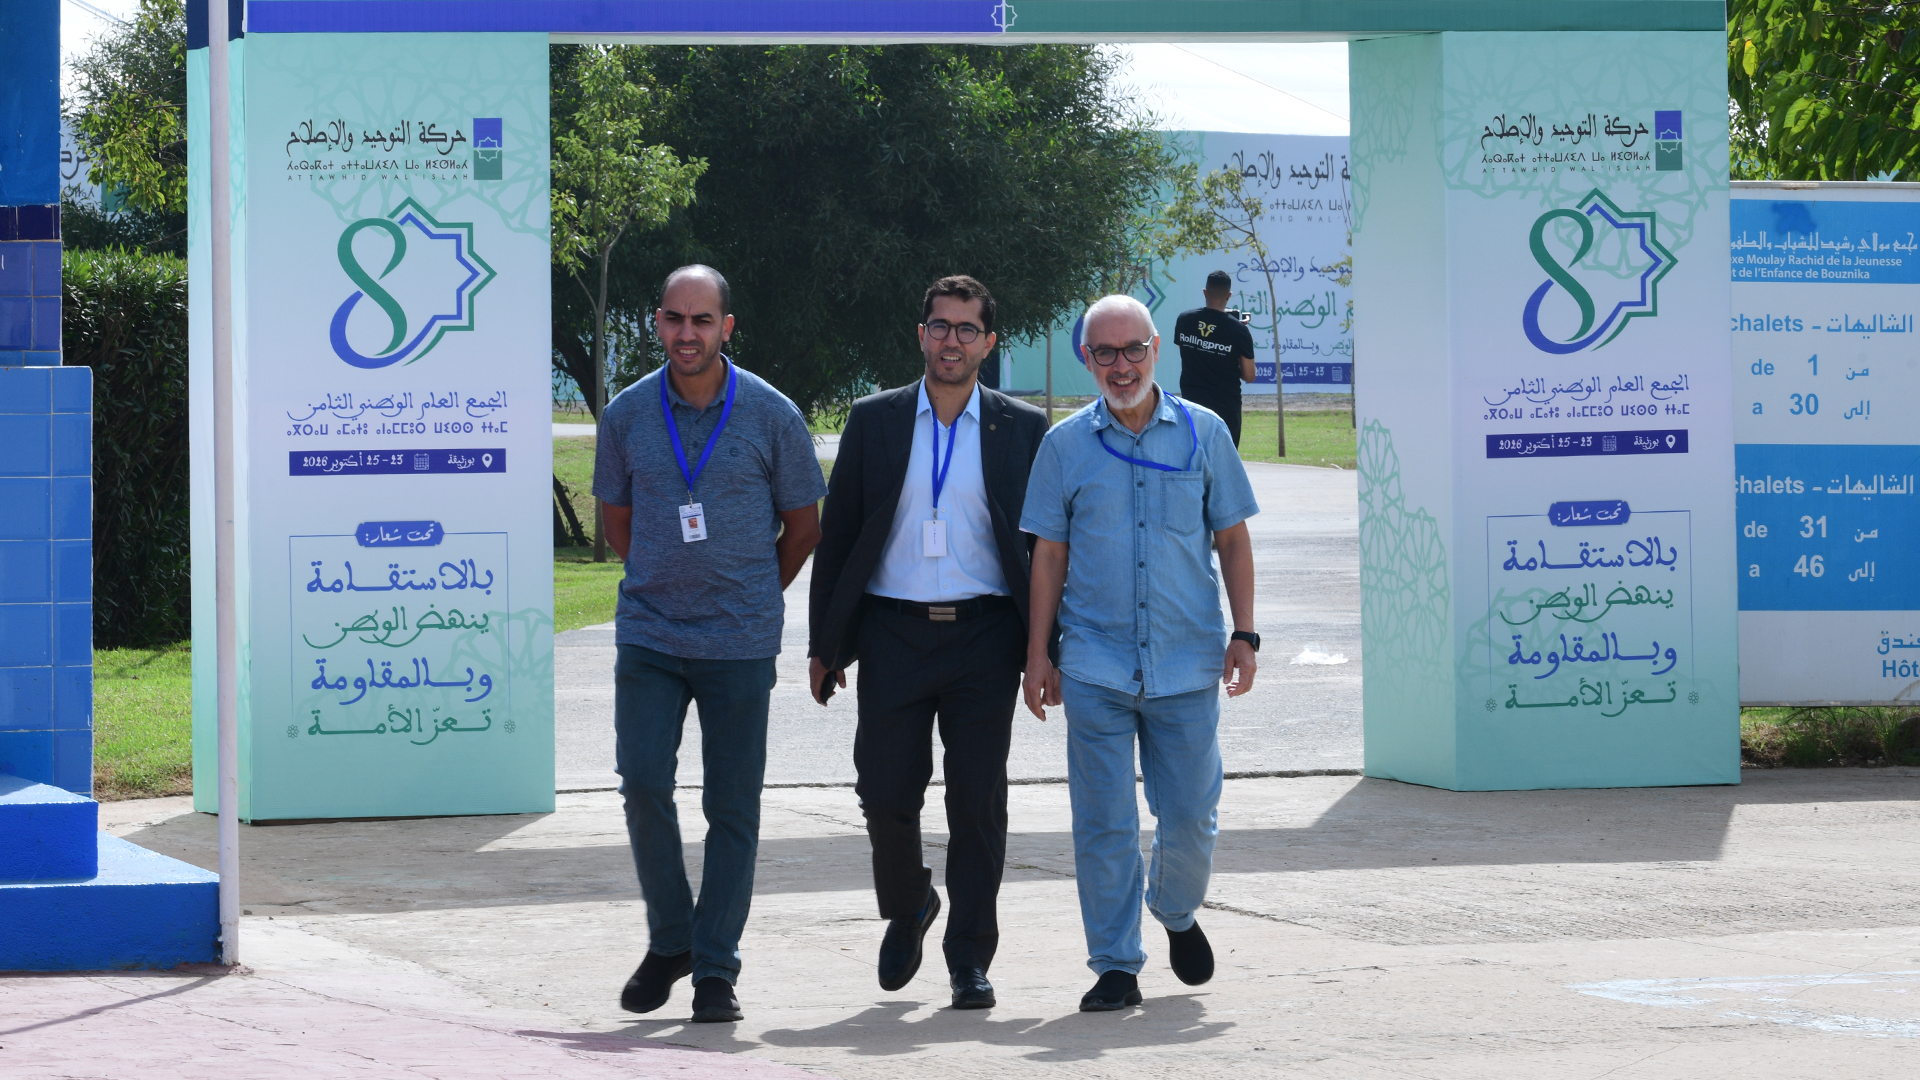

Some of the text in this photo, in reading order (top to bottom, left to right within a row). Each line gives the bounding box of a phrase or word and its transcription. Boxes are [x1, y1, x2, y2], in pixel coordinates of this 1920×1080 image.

[286, 119, 467, 157] حركة التوحيد والإصلاح
[1481, 112, 1649, 150] حركة التوحيد والإصلاح
[1820, 236, 1854, 254] رشيد
[1857, 232, 1890, 252] مولاي
[1892, 232, 1918, 255] مجمع
[1746, 254, 1786, 267] Moulay
[1788, 254, 1824, 266] Rachid
[1826, 255, 1840, 266] de
[1842, 255, 1852, 266] la
[1854, 256, 1902, 266] Jeunesse
[1738, 267, 1752, 278] de
[1805, 268, 1818, 278] de
[1821, 268, 1870, 279] Bouznika
[1826, 313, 1913, 339] الشاليهات
[1180, 332, 1232, 352] Rollingprod
[1750, 354, 1870, 380] de 1 من
[1484, 374, 1690, 406] الجمع العام الوطني الثامن
[286, 391, 508, 421] الجمع العام الوطني الثامن
[1752, 393, 1870, 420] a 30 إلى
[1498, 438, 1522, 450] 2026
[1518, 434, 1555, 454] أكتوبر
[1558, 436, 1570, 448] 25
[1580, 436, 1592, 446] 23
[1634, 436, 1660, 450] بوزنيقة
[302, 456, 328, 467] 2026
[323, 452, 362, 472] أكتوبر
[366, 454, 380, 466] 25
[390, 454, 404, 465] 23
[448, 454, 475, 470] بوزنيقة
[1827, 474, 1914, 500] الشاليهات
[1596, 502, 1622, 520] تحت
[406, 524, 434, 541] تحت
[1744, 515, 1878, 542] de 31 من
[1749, 554, 1875, 582] a 46 إلى
[1500, 582, 1598, 626] الوطن
[302, 606, 408, 650] الوطن
[1882, 660, 1920, 678] Hôt
